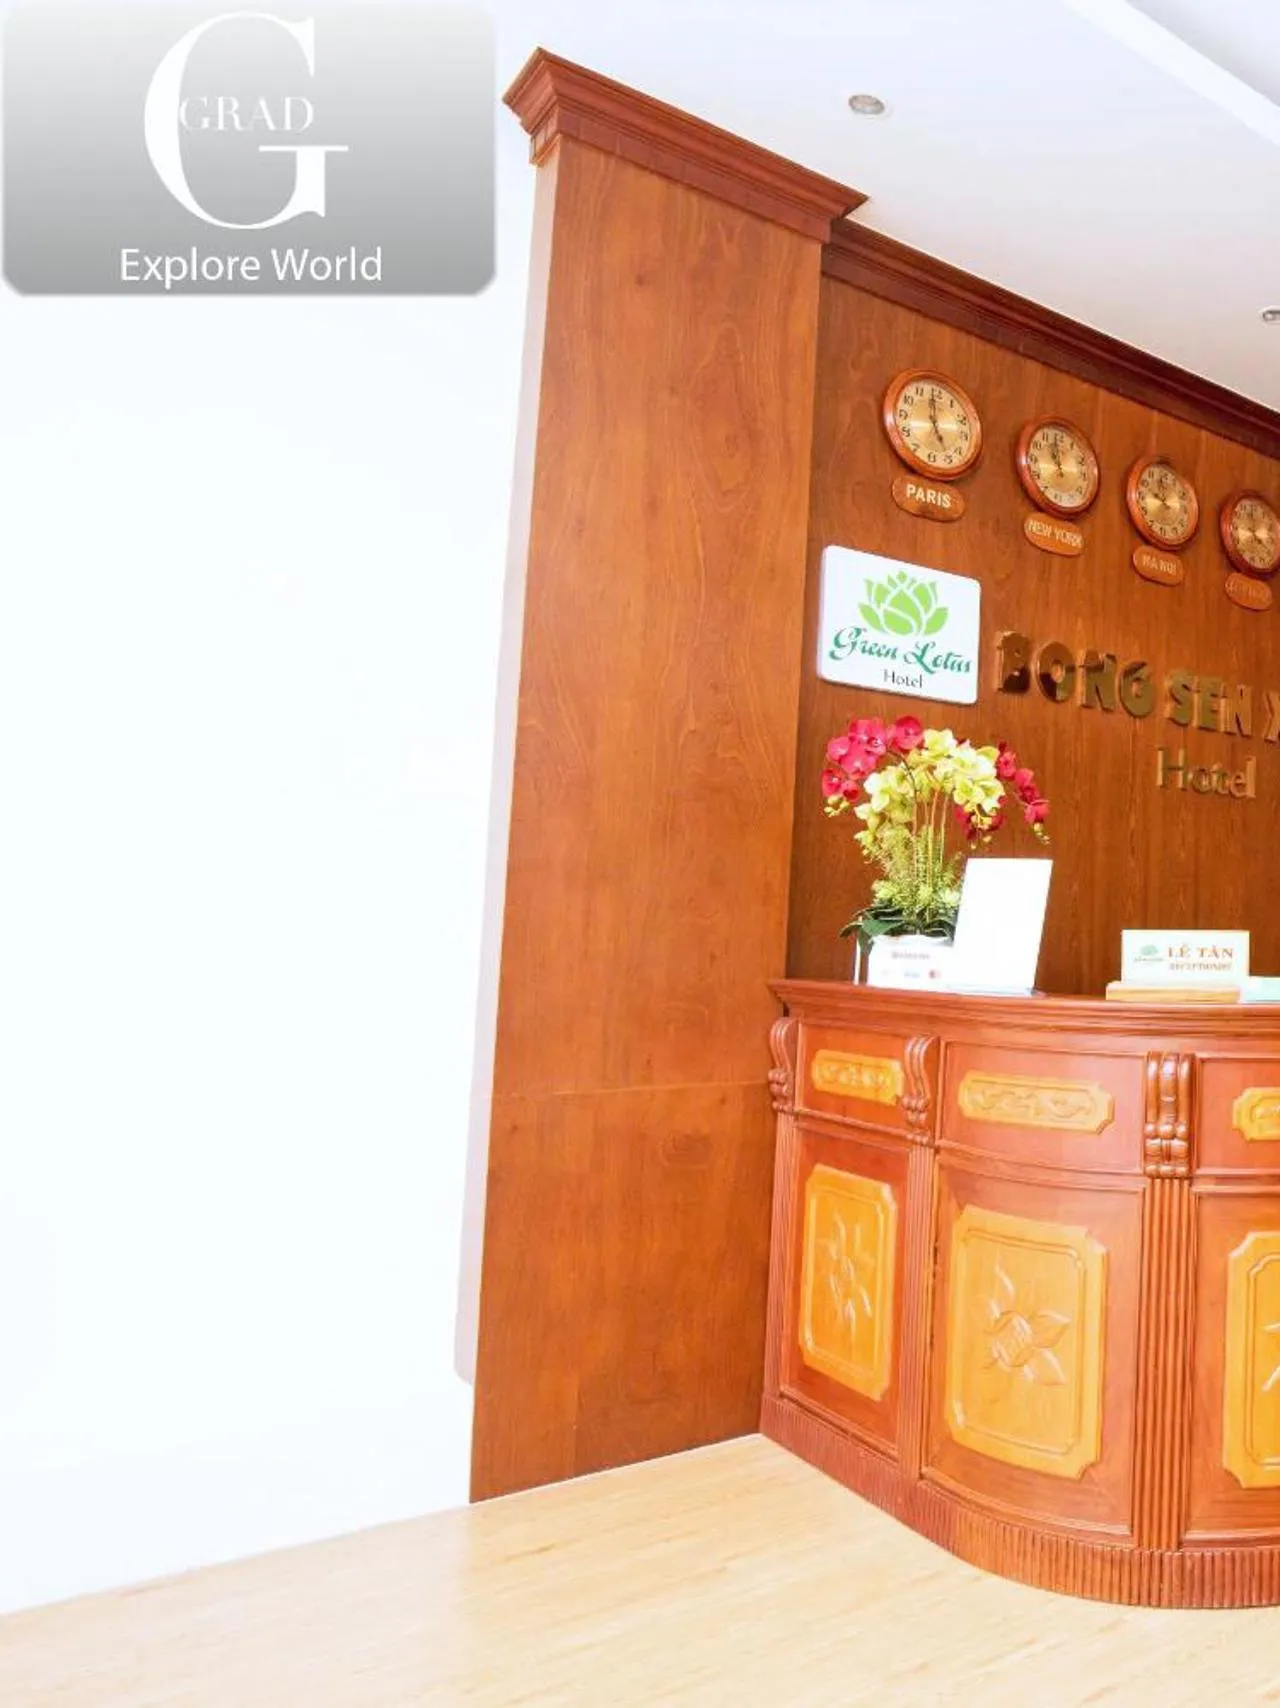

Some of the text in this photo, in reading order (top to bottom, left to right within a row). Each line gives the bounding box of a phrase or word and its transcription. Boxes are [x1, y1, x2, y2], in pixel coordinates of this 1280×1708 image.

[906, 483, 952, 509] PARIS
[1027, 518, 1053, 538] NEW
[829, 626, 972, 674] Green Lotus
[884, 668, 924, 688] Hotel
[1164, 668, 1253, 737] SEN
[1156, 747, 1257, 799] Hotel
